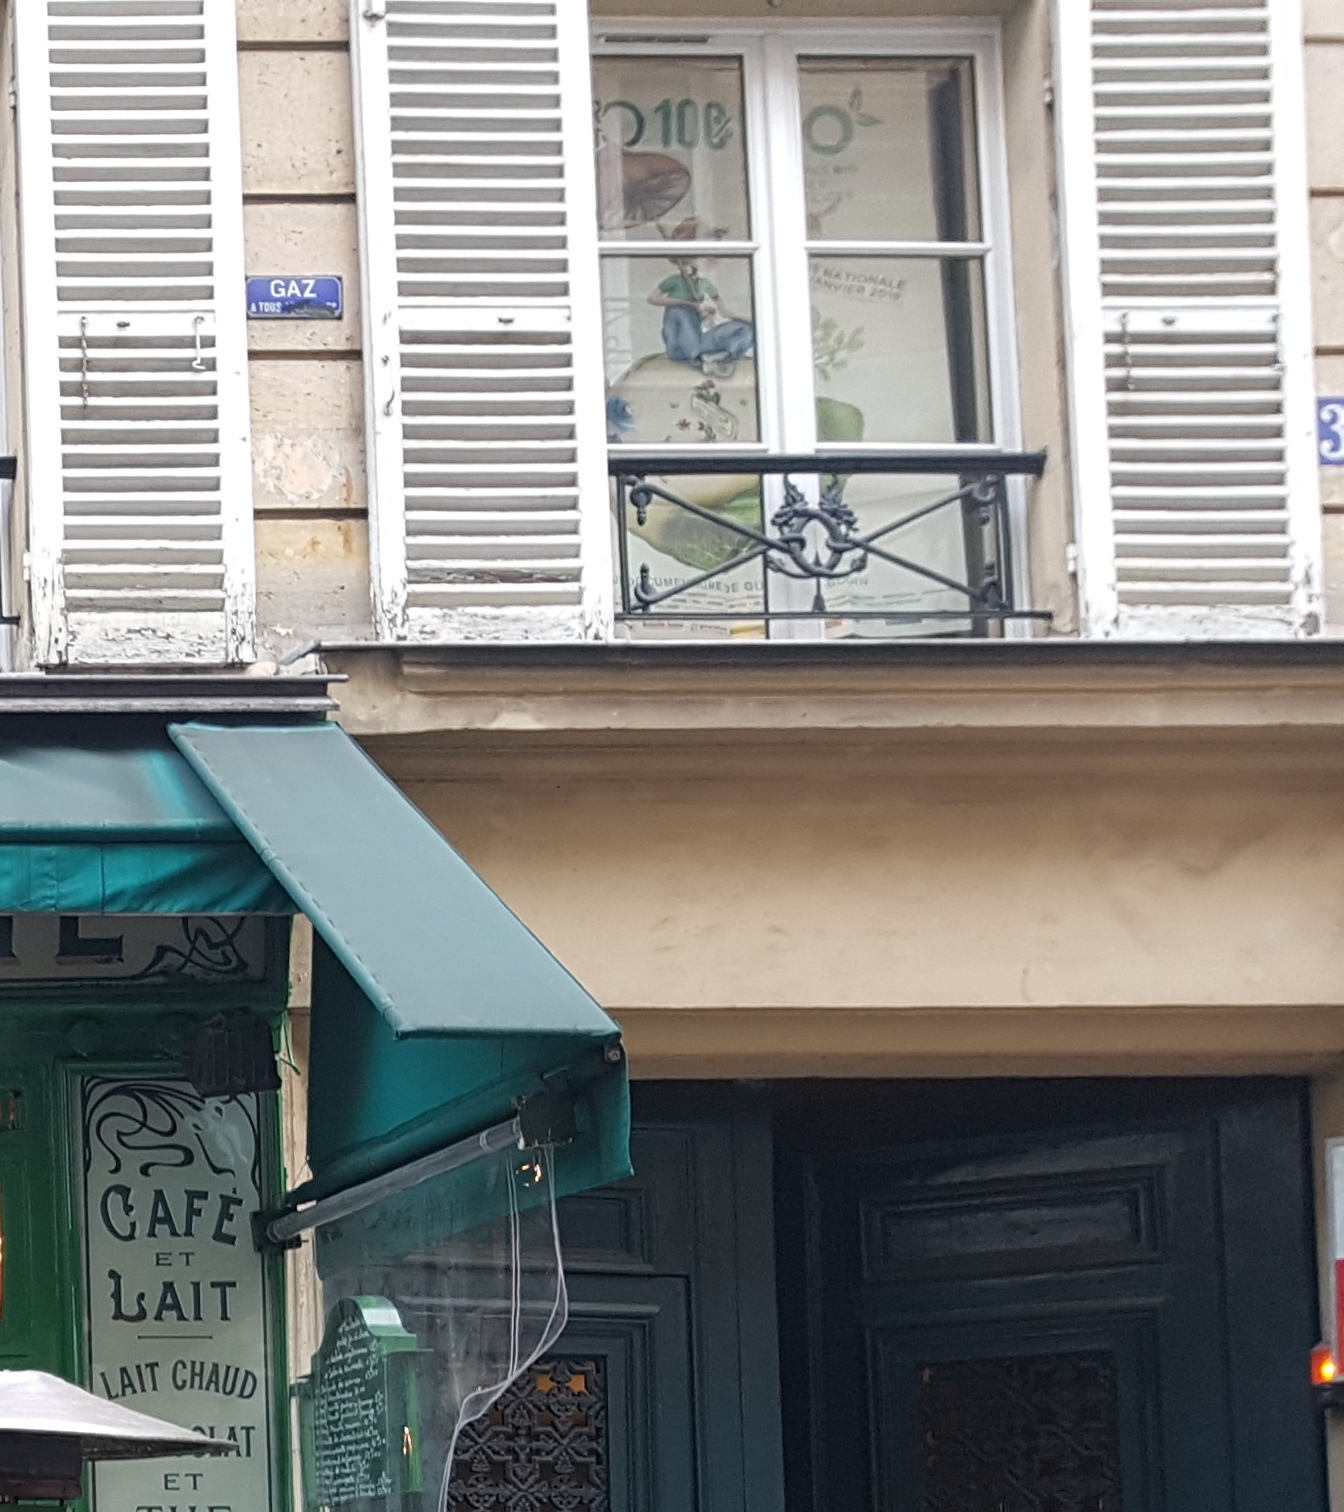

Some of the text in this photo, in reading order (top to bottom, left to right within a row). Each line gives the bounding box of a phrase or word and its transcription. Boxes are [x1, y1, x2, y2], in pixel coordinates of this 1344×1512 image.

[270, 279, 317, 298] GAZ
[259, 302, 283, 313] TOUS
[100, 1184, 244, 1247] CAFÉ
[155, 1251, 196, 1267] ET
[107, 1269, 238, 1323] LAIT
[100, 1358, 259, 1401] LAIT CHAUD
[163, 1473, 205, 1491] ET
